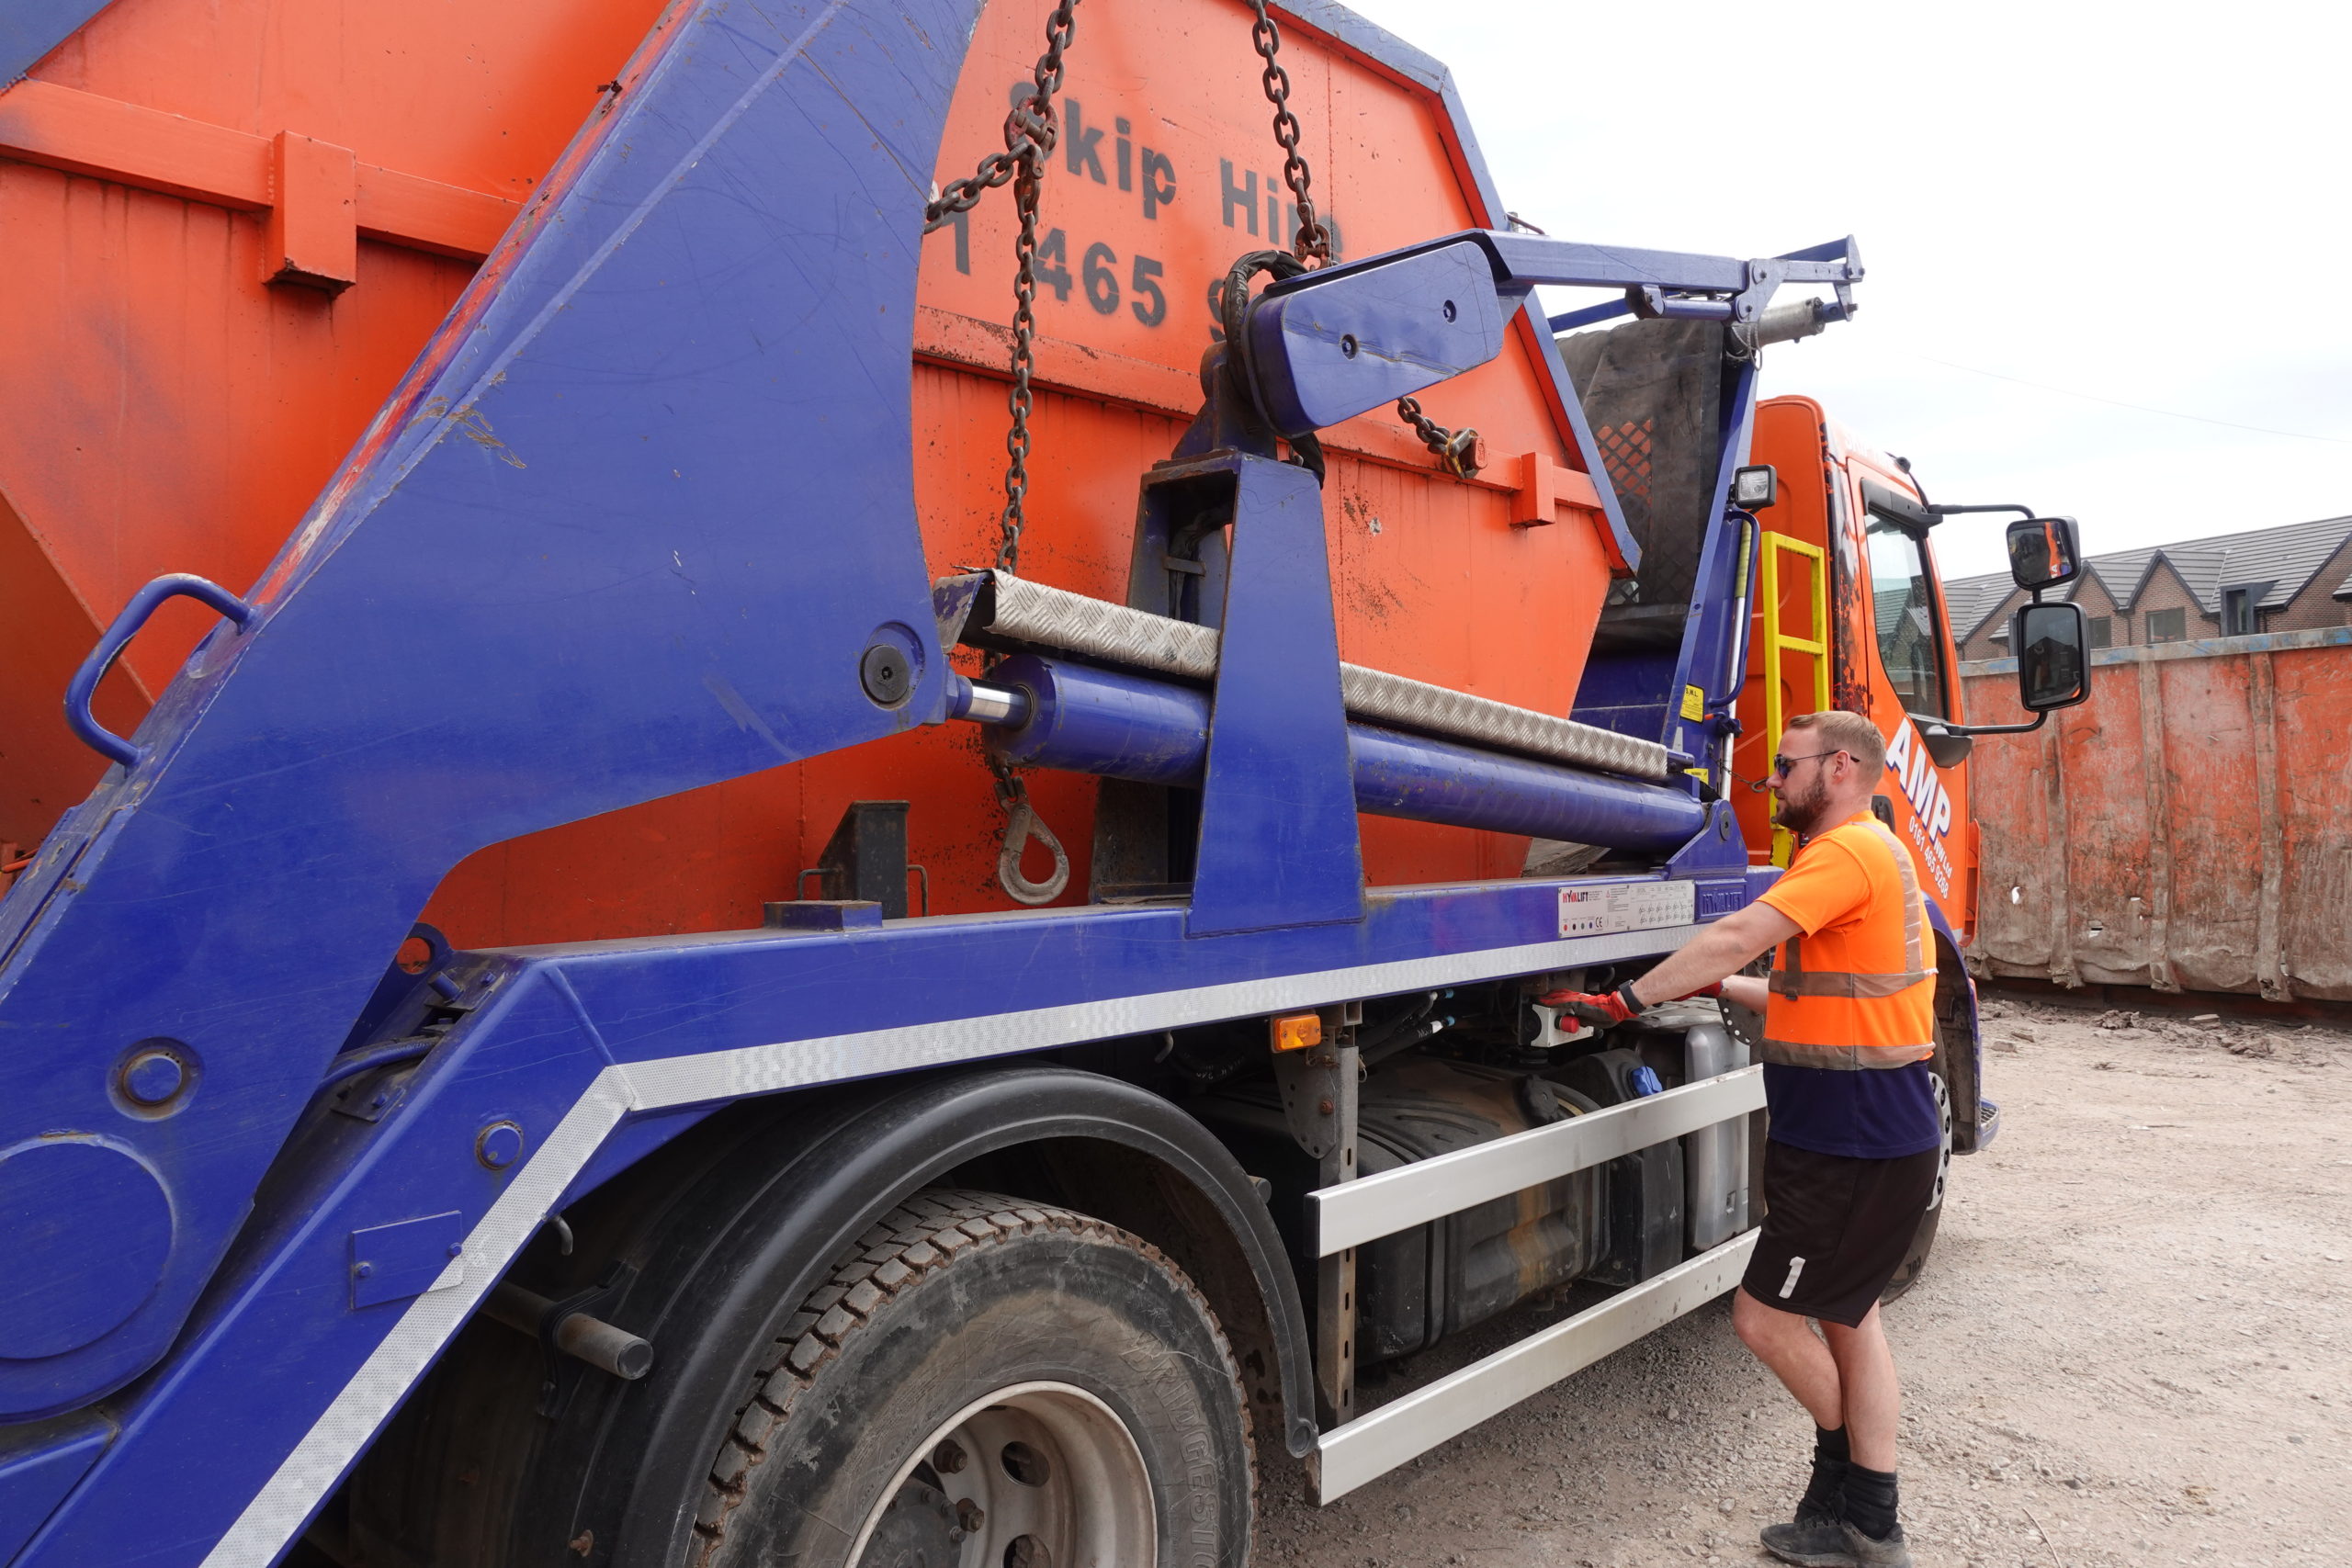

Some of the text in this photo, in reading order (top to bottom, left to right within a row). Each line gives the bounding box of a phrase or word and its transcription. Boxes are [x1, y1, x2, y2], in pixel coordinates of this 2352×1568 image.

[1033, 227, 1167, 328] 465
[1885, 717, 1951, 846] AMP
[1908, 815, 1950, 900] 0161 465 9268
[1933, 837, 1953, 880] NW Ltd
